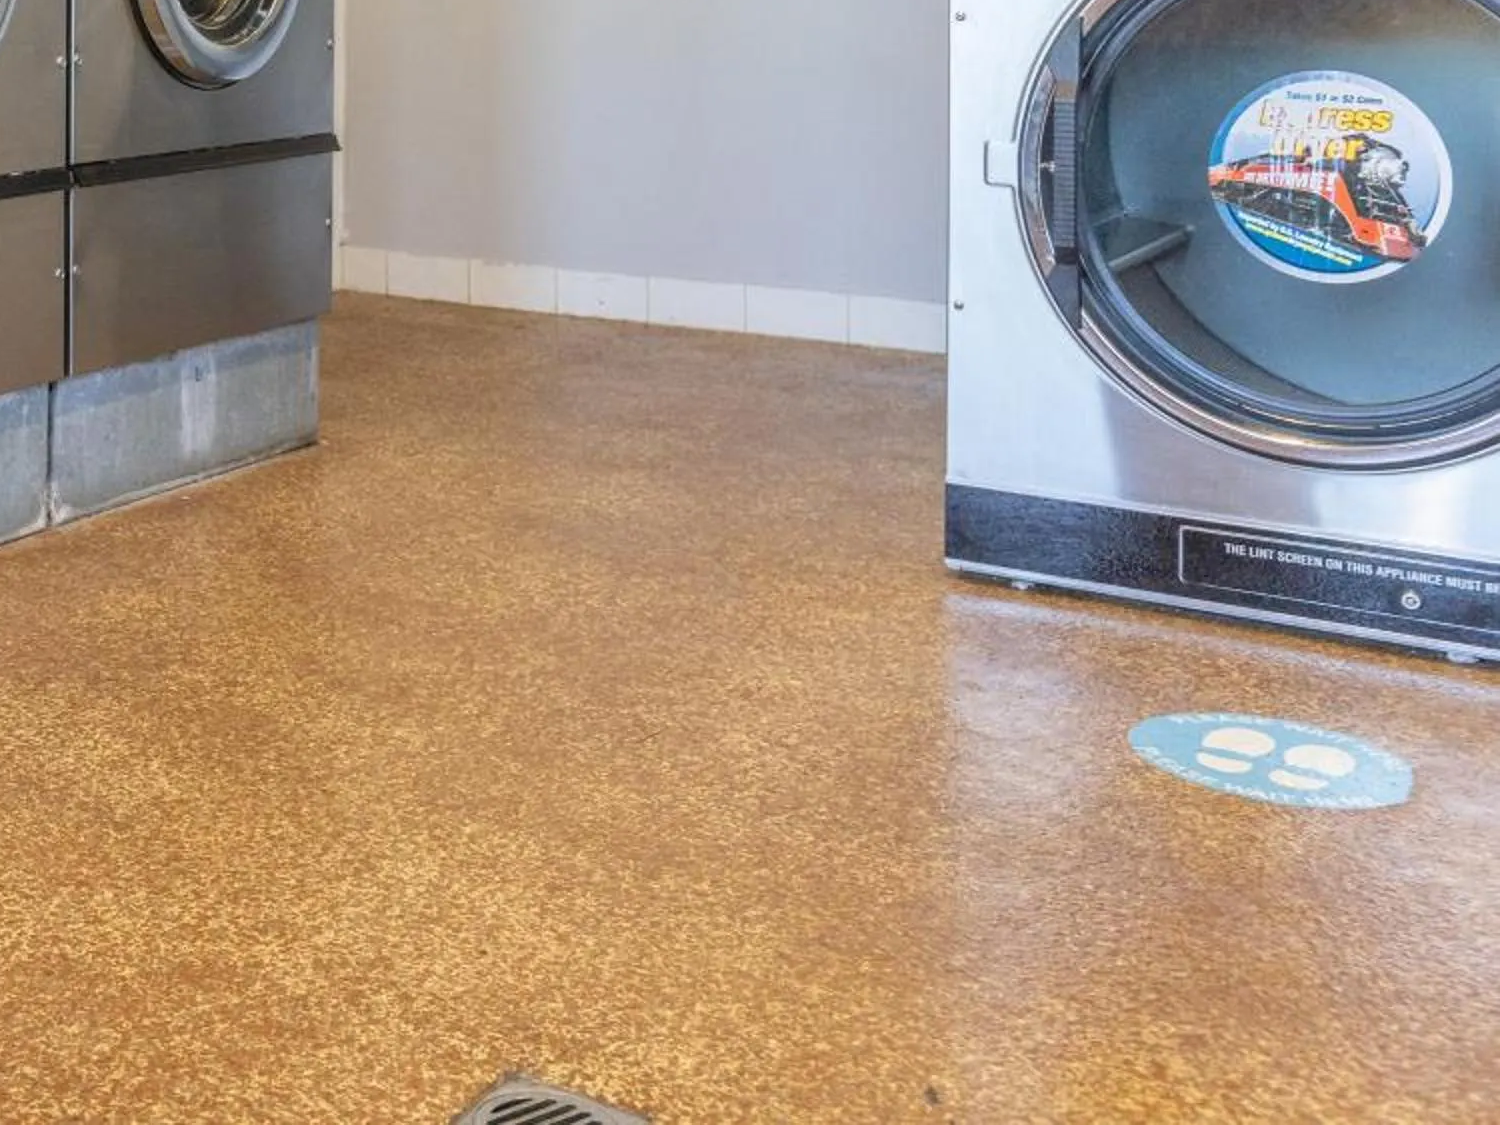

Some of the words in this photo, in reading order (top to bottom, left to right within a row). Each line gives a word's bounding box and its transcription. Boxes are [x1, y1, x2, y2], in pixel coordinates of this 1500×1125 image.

[1224, 542, 1247, 557] THE
[1249, 546, 1275, 561] LINT
[1277, 549, 1324, 569] SCREEN
[1325, 557, 1343, 571] ON
[1346, 560, 1373, 577] THIS
[1376, 565, 1443, 586] APPLIANCE
[1445, 574, 1481, 591] MUST
